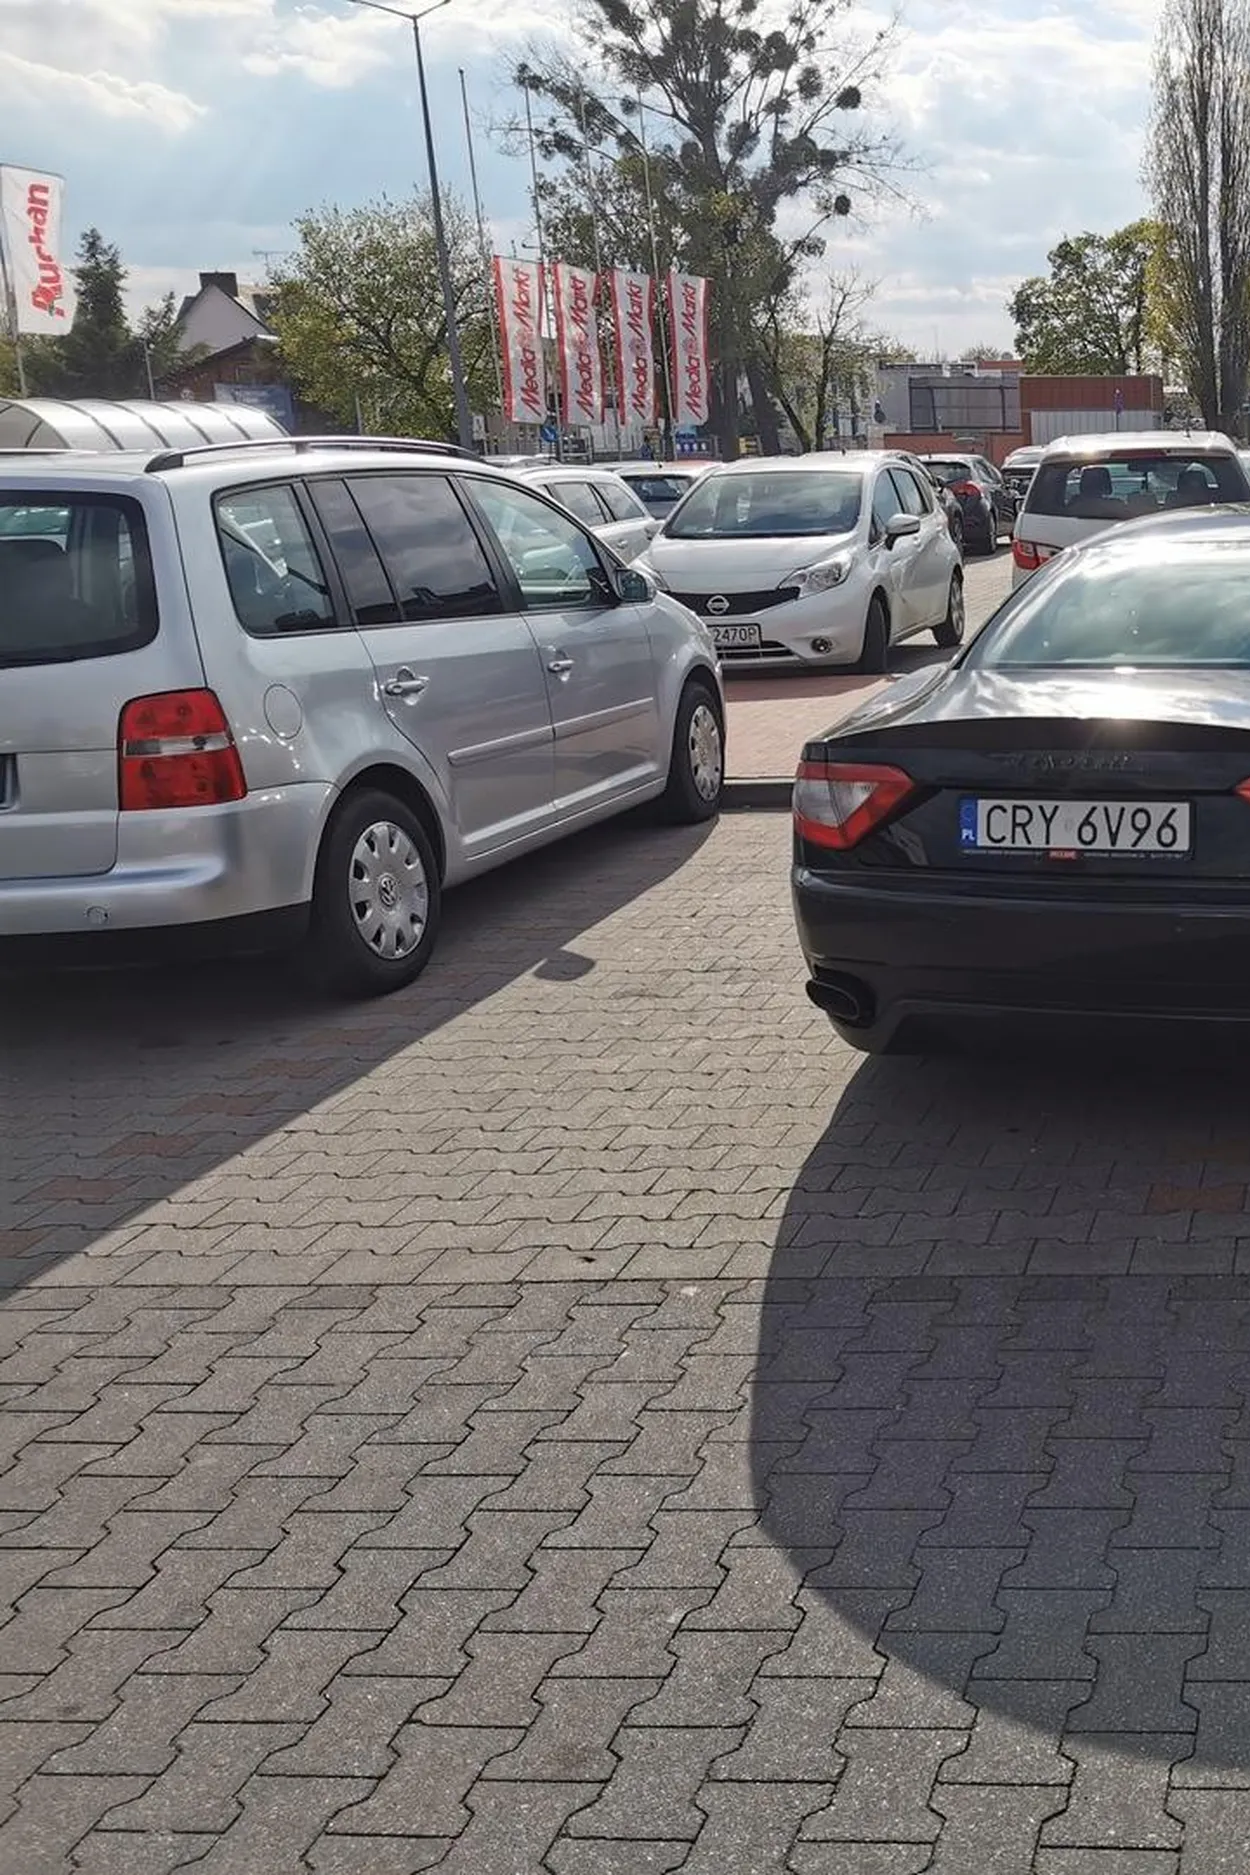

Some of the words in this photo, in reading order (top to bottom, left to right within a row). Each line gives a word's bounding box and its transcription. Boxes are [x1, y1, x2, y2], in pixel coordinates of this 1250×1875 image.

[513, 267, 532, 332] Markt
[571, 275, 589, 337] Markt
[627, 280, 645, 341] Markt
[682, 281, 697, 337] Markt
[520, 348, 542, 417] Media
[576, 352, 595, 420] Media
[632, 357, 648, 419] Media
[685, 355, 702, 420] Media
[713, 626, 757, 642] 2470P
[961, 829, 974, 840] PL
[986, 805, 1059, 845] CRY
[1077, 806, 1178, 848] 6V96
